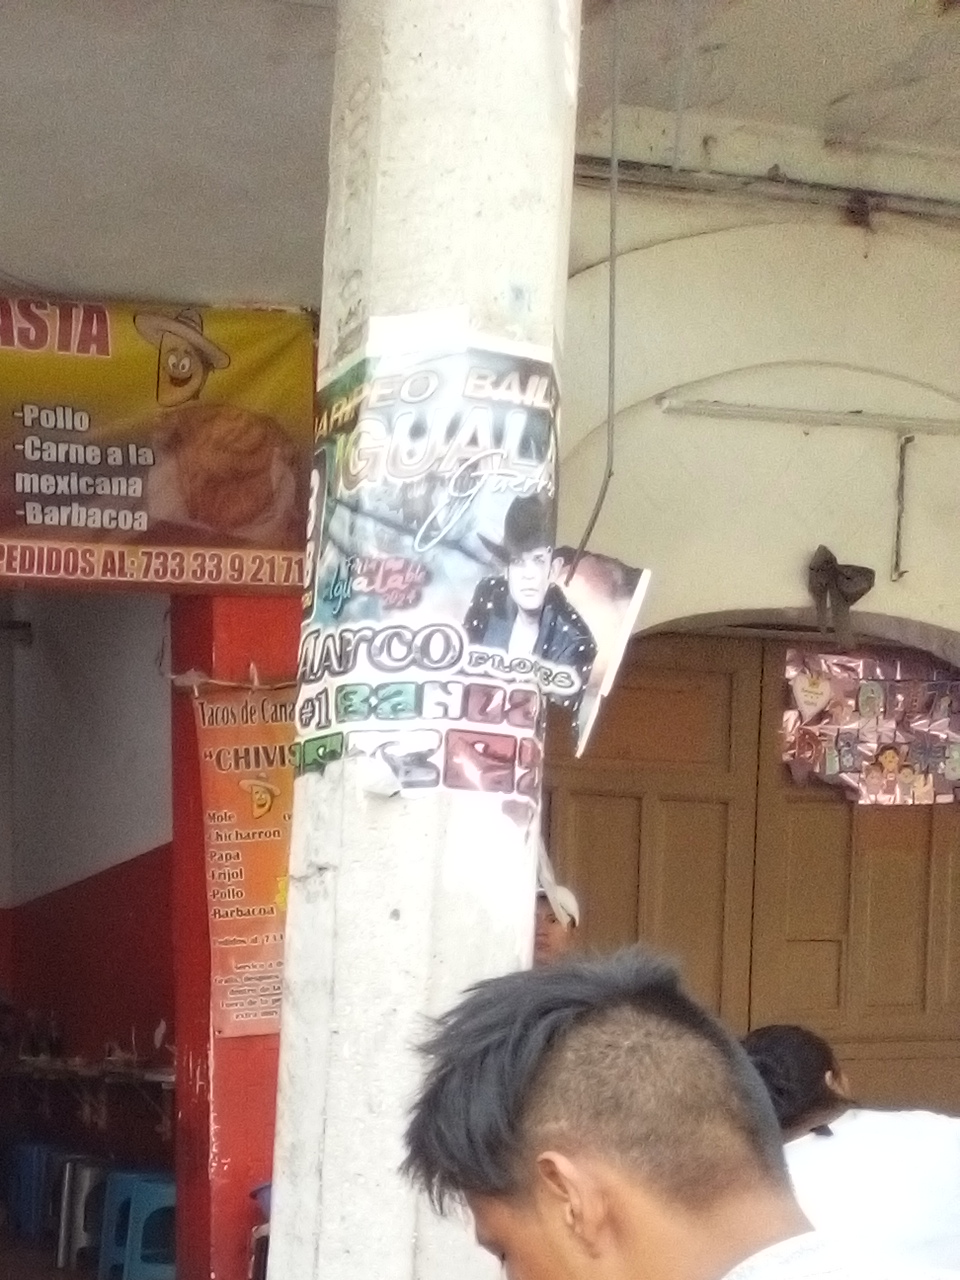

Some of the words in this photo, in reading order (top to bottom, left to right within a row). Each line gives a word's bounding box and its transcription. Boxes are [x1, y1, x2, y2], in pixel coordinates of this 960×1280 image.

[13, 404, 90, 432] -Pollo
[14, 435, 102, 465] -Carne
[106, 446, 123, 466] a
[128, 443, 154, 466] la
[335, 405, 553, 492] IGUAL
[15, 471, 143, 498] mexicana
[15, 501, 149, 532] -Barbacoa
[100, 549, 137, 580] AL:
[141, 550, 185, 582] 733
[191, 552, 222, 582] 33
[229, 552, 244, 582] 9
[198, 701, 237, 728] Tacos
[241, 699, 257, 726] de
[261, 698, 296, 724] Cana
